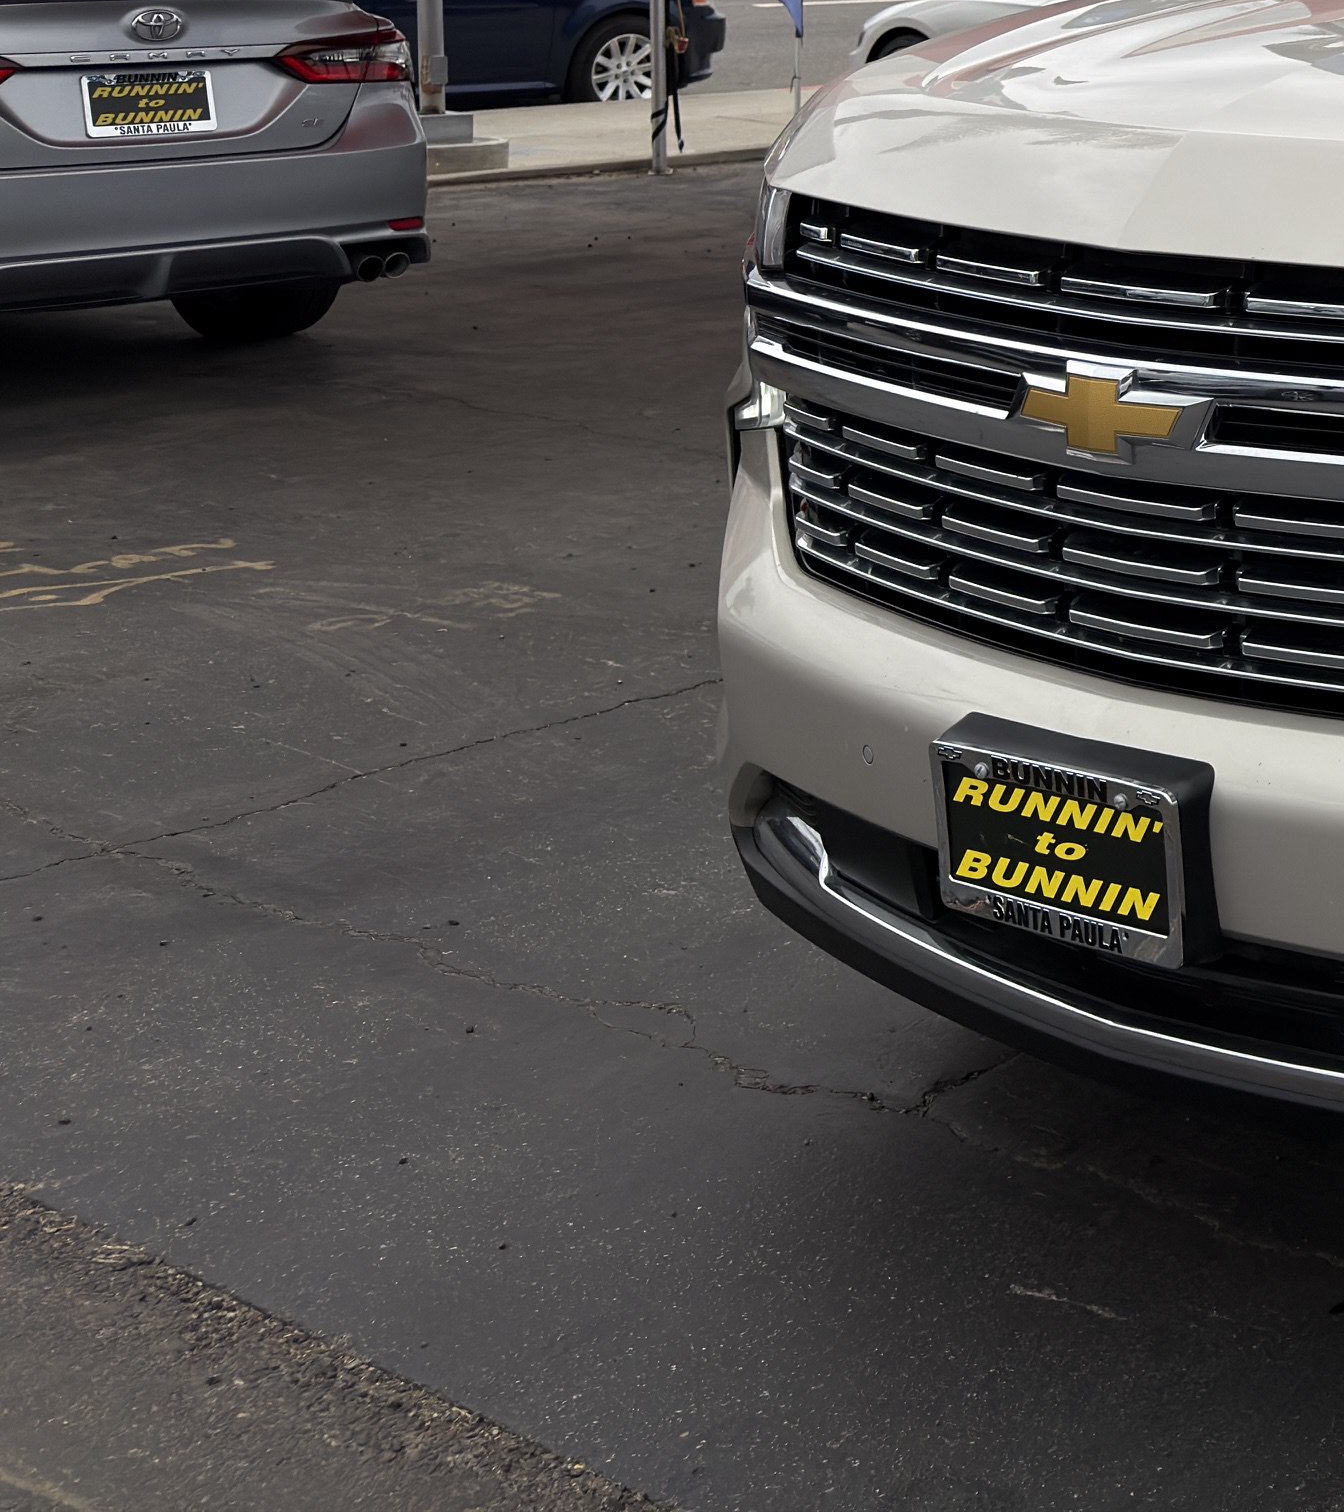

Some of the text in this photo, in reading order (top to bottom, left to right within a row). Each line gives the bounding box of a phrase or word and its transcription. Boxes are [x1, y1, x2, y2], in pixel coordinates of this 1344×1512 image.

[69, 48, 241, 63] CAMRY
[115, 72, 179, 84] BUNNIN
[92, 82, 205, 99] RUNNIN'
[137, 98, 165, 108] to
[95, 108, 203, 126] BUNNIN
[119, 122, 189, 135] SANTA PAULA
[991, 754, 1108, 802] BUNNIN
[953, 776, 1164, 843] RUNNIN'
[1034, 831, 1087, 861] to
[955, 848, 1161, 921] BUNNIN
[992, 895, 1124, 954] SANTA PAULA
